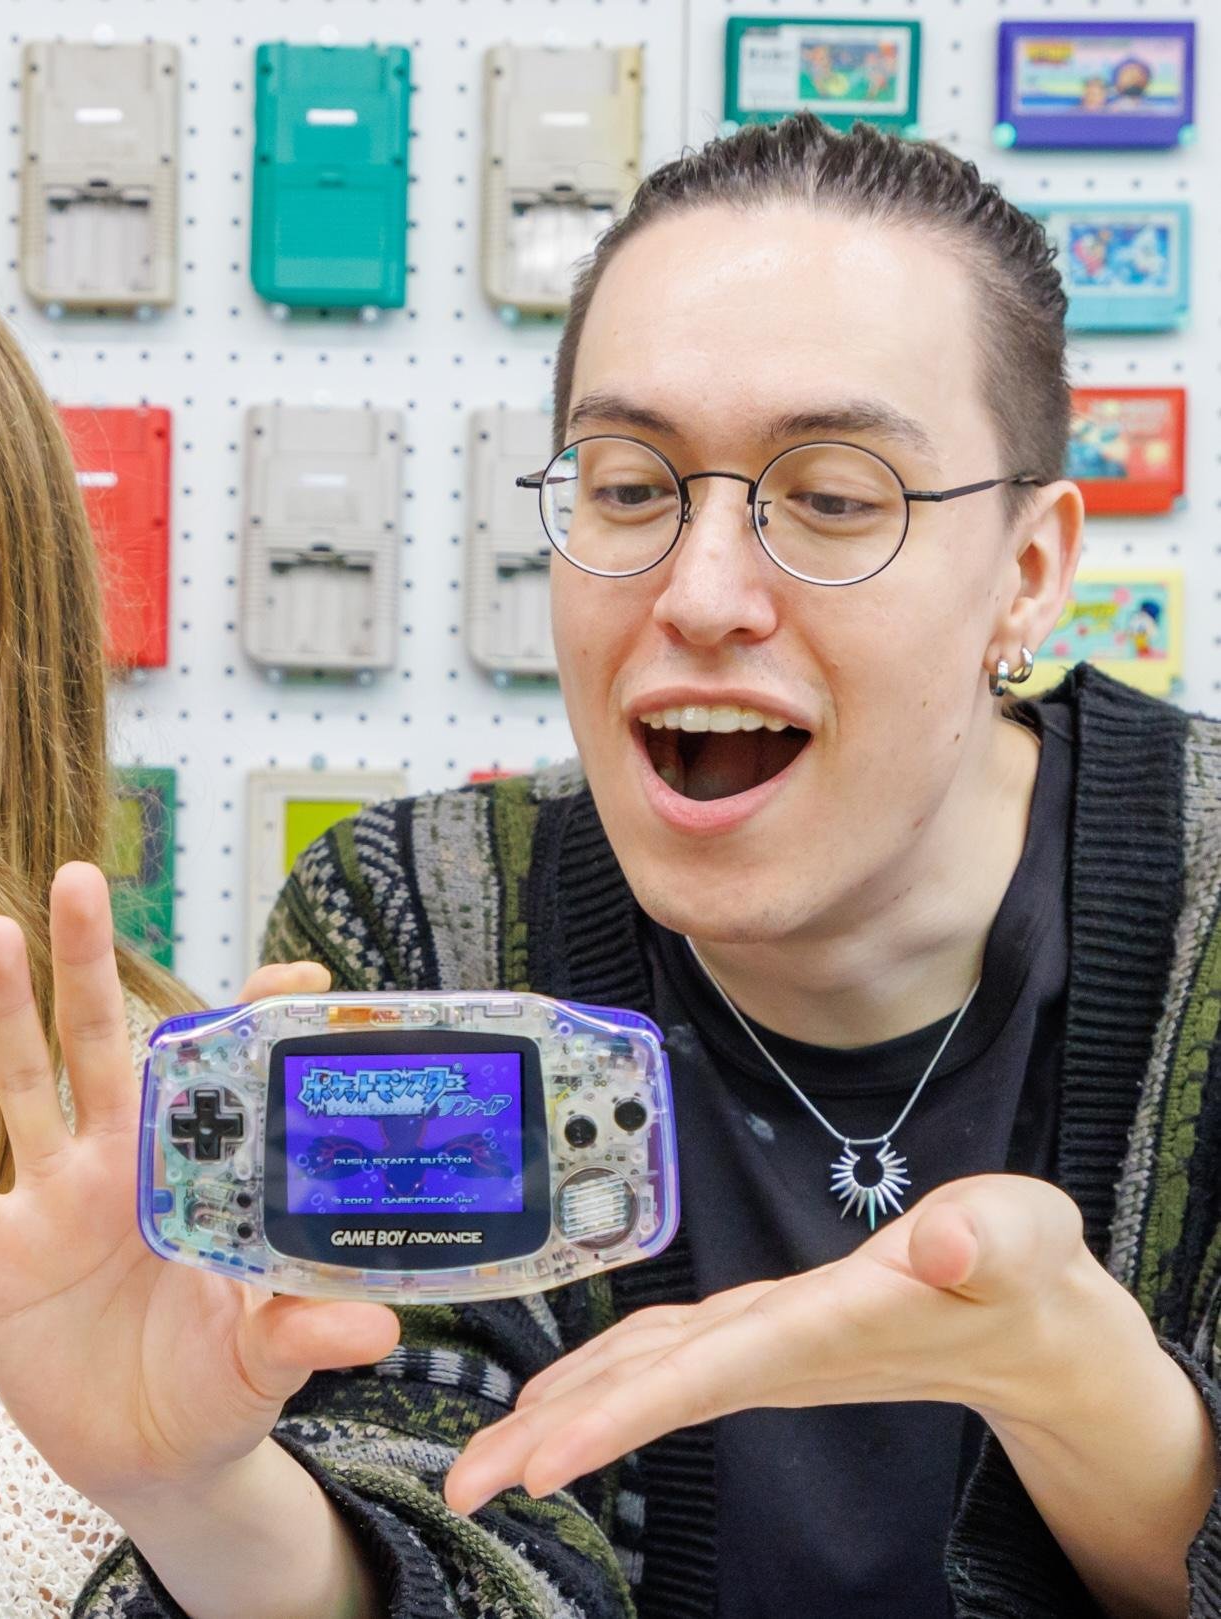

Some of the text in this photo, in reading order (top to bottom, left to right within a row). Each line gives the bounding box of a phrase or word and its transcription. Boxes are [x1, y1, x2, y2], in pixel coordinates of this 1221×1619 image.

[372, 1157, 415, 1165] START
[331, 1230, 483, 1246] GAME BOY ADVANCE
